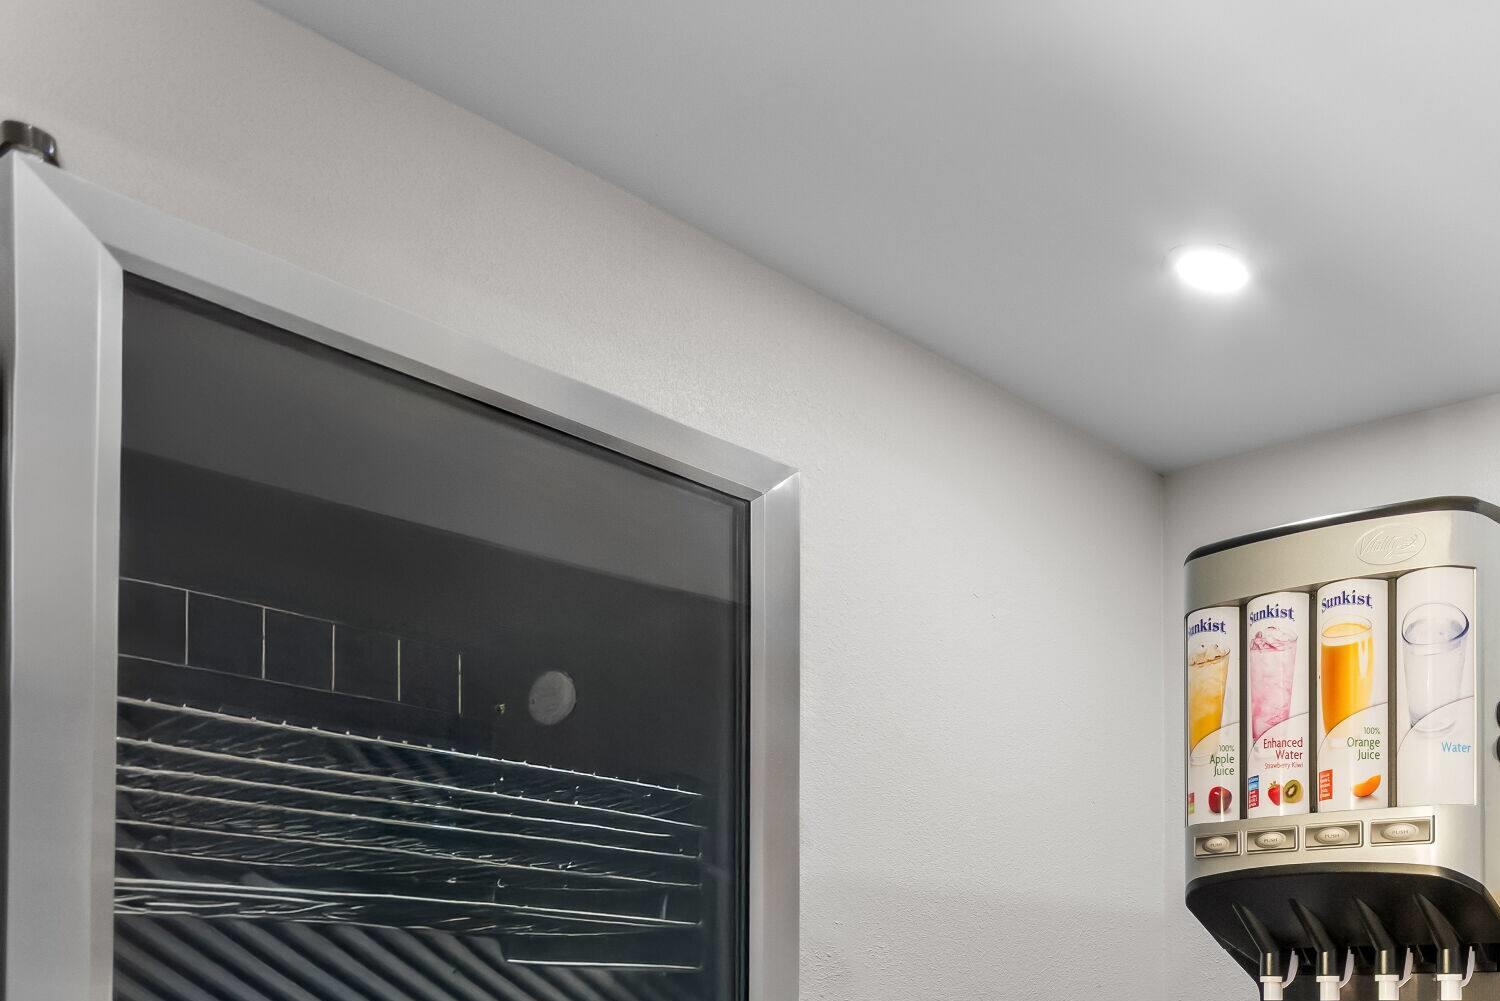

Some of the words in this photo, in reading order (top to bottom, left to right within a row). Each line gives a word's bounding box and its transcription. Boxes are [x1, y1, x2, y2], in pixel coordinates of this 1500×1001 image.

[1322, 590, 1373, 614] Sunkist
[1250, 604, 1295, 625] Sunkist
[1364, 727, 1380, 735] 100%
[1218, 744, 1235, 752] 100%
[1264, 737, 1303, 749] Enhanced
[1346, 737, 1380, 750] Orange
[1442, 742, 1472, 752] Water
[1210, 754, 1235, 767] Apple
[1276, 750, 1303, 760] Water
[1358, 750, 1380, 761] Juice
[1214, 766, 1235, 777] Juice
